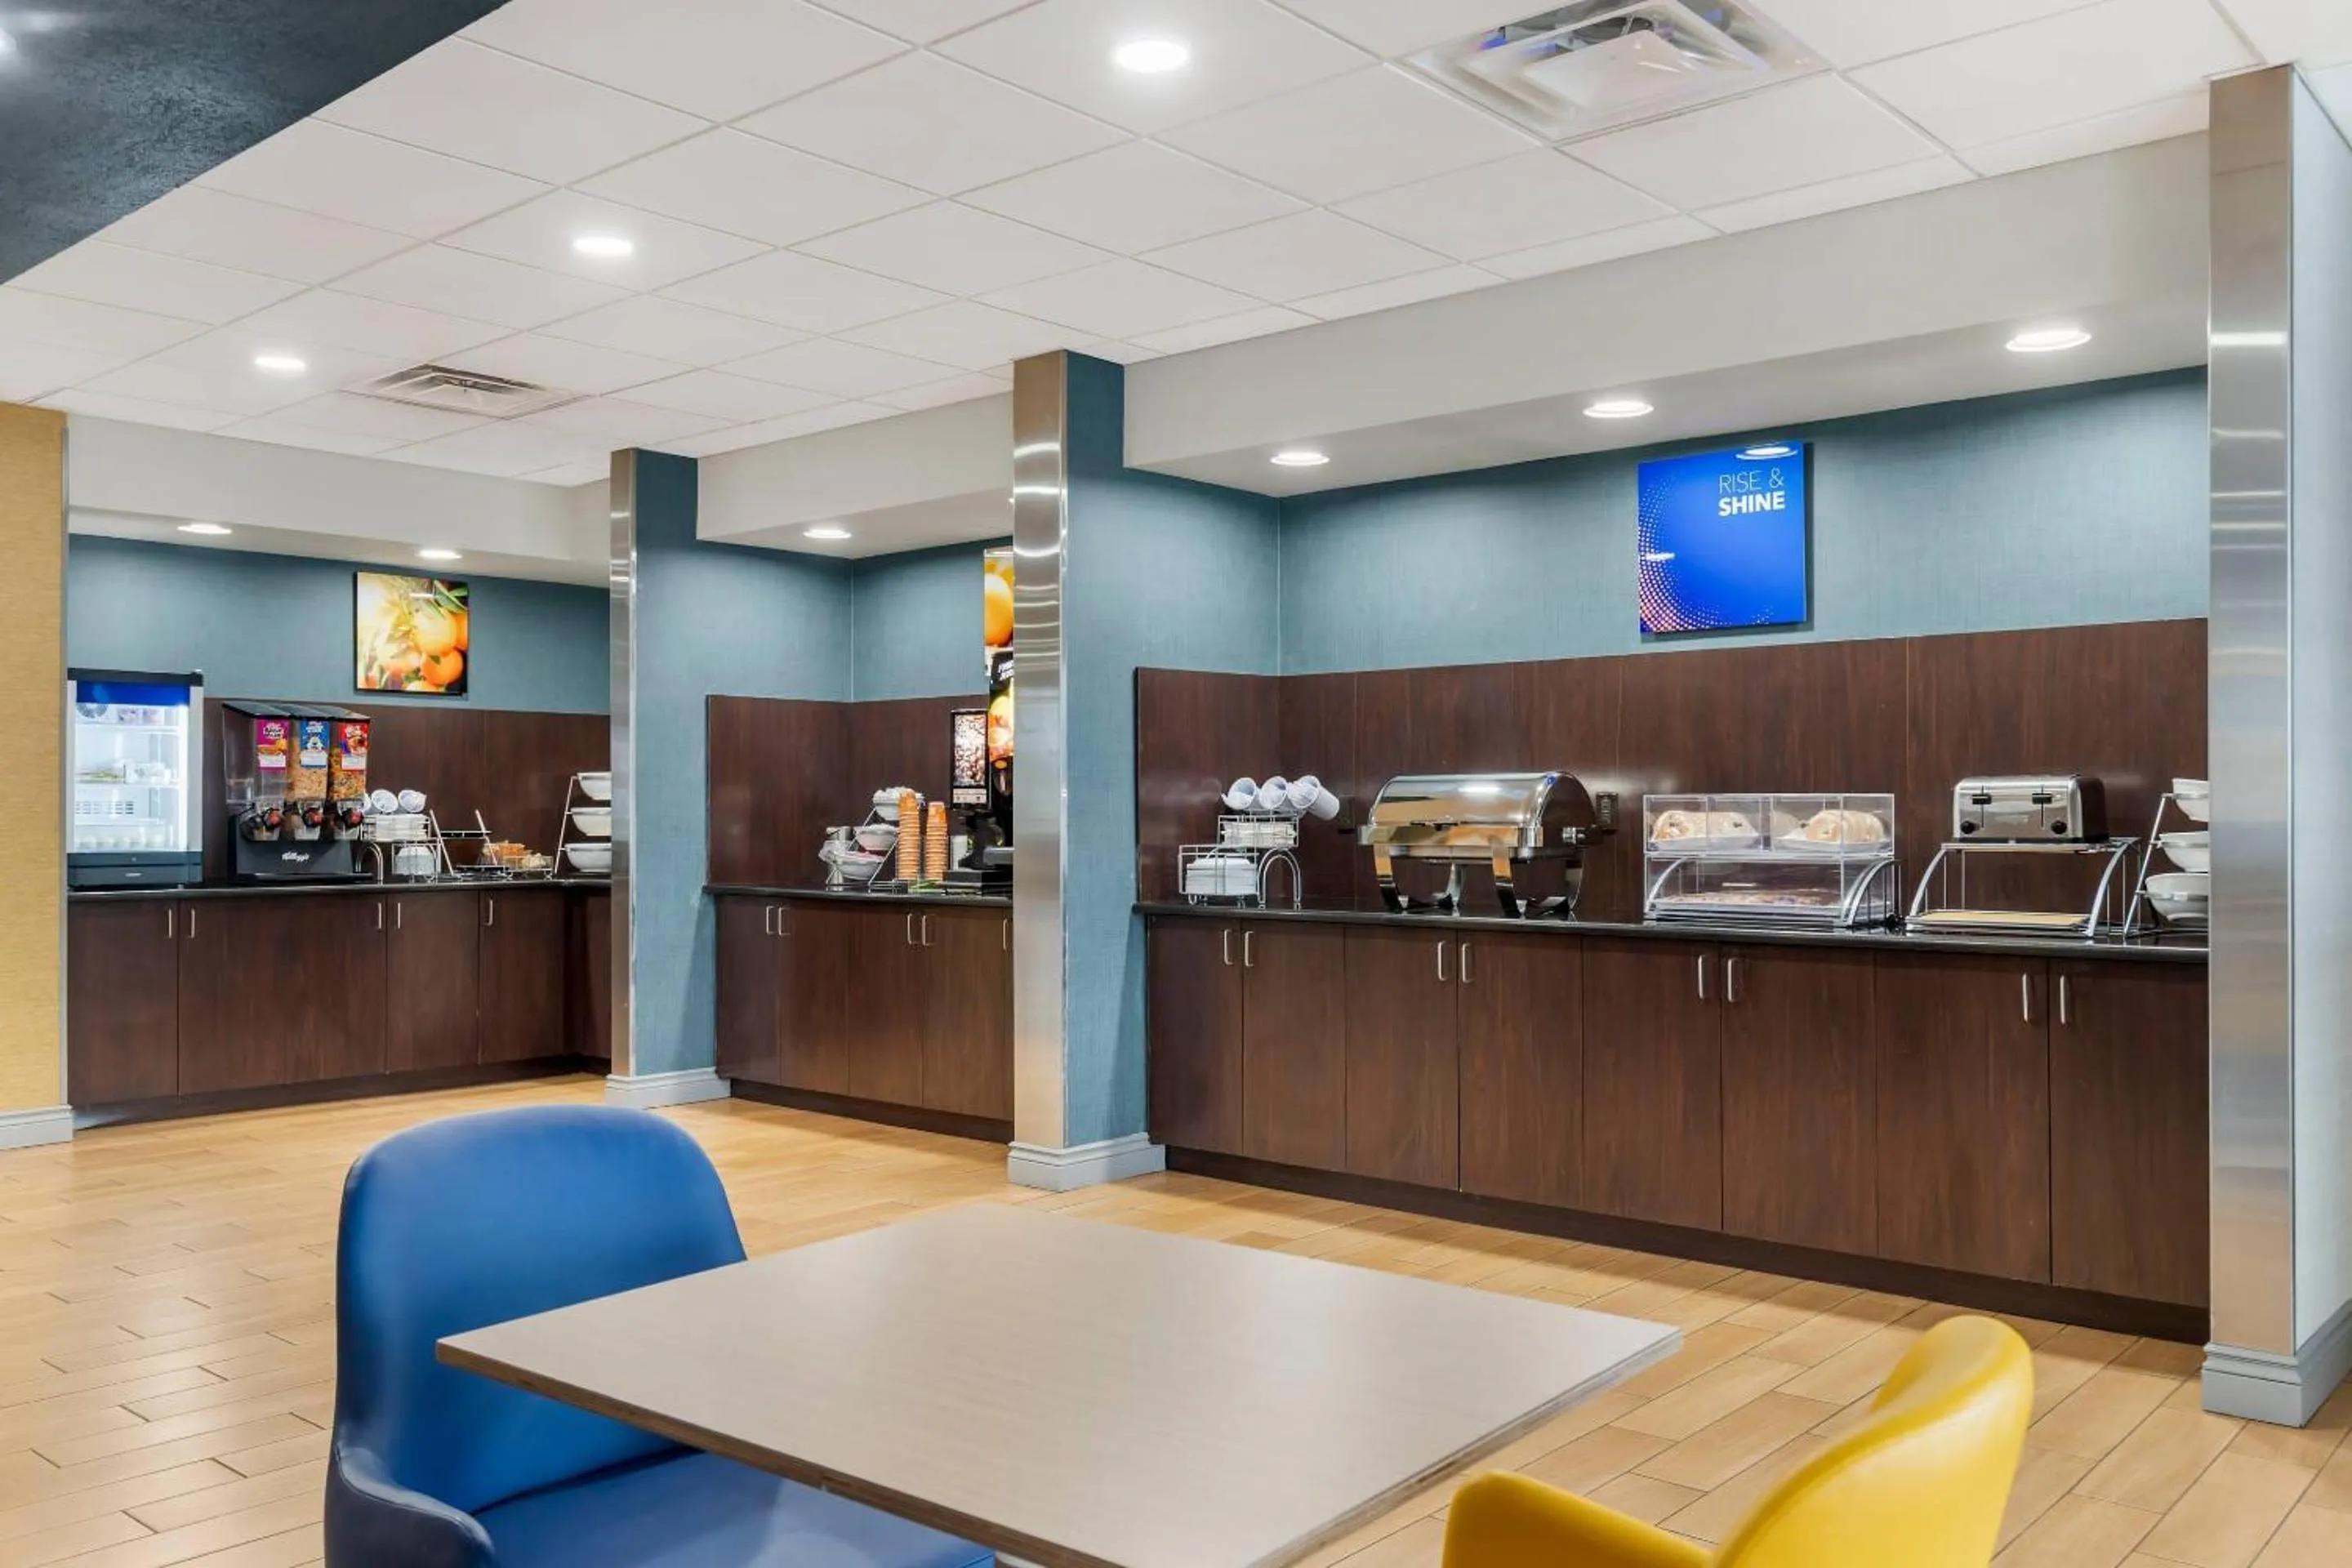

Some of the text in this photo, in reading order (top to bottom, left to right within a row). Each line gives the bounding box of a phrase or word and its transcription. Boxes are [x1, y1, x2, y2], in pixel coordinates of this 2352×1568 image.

[1718, 466, 1784, 494] RISE &
[1718, 490, 1785, 516] SHINE
